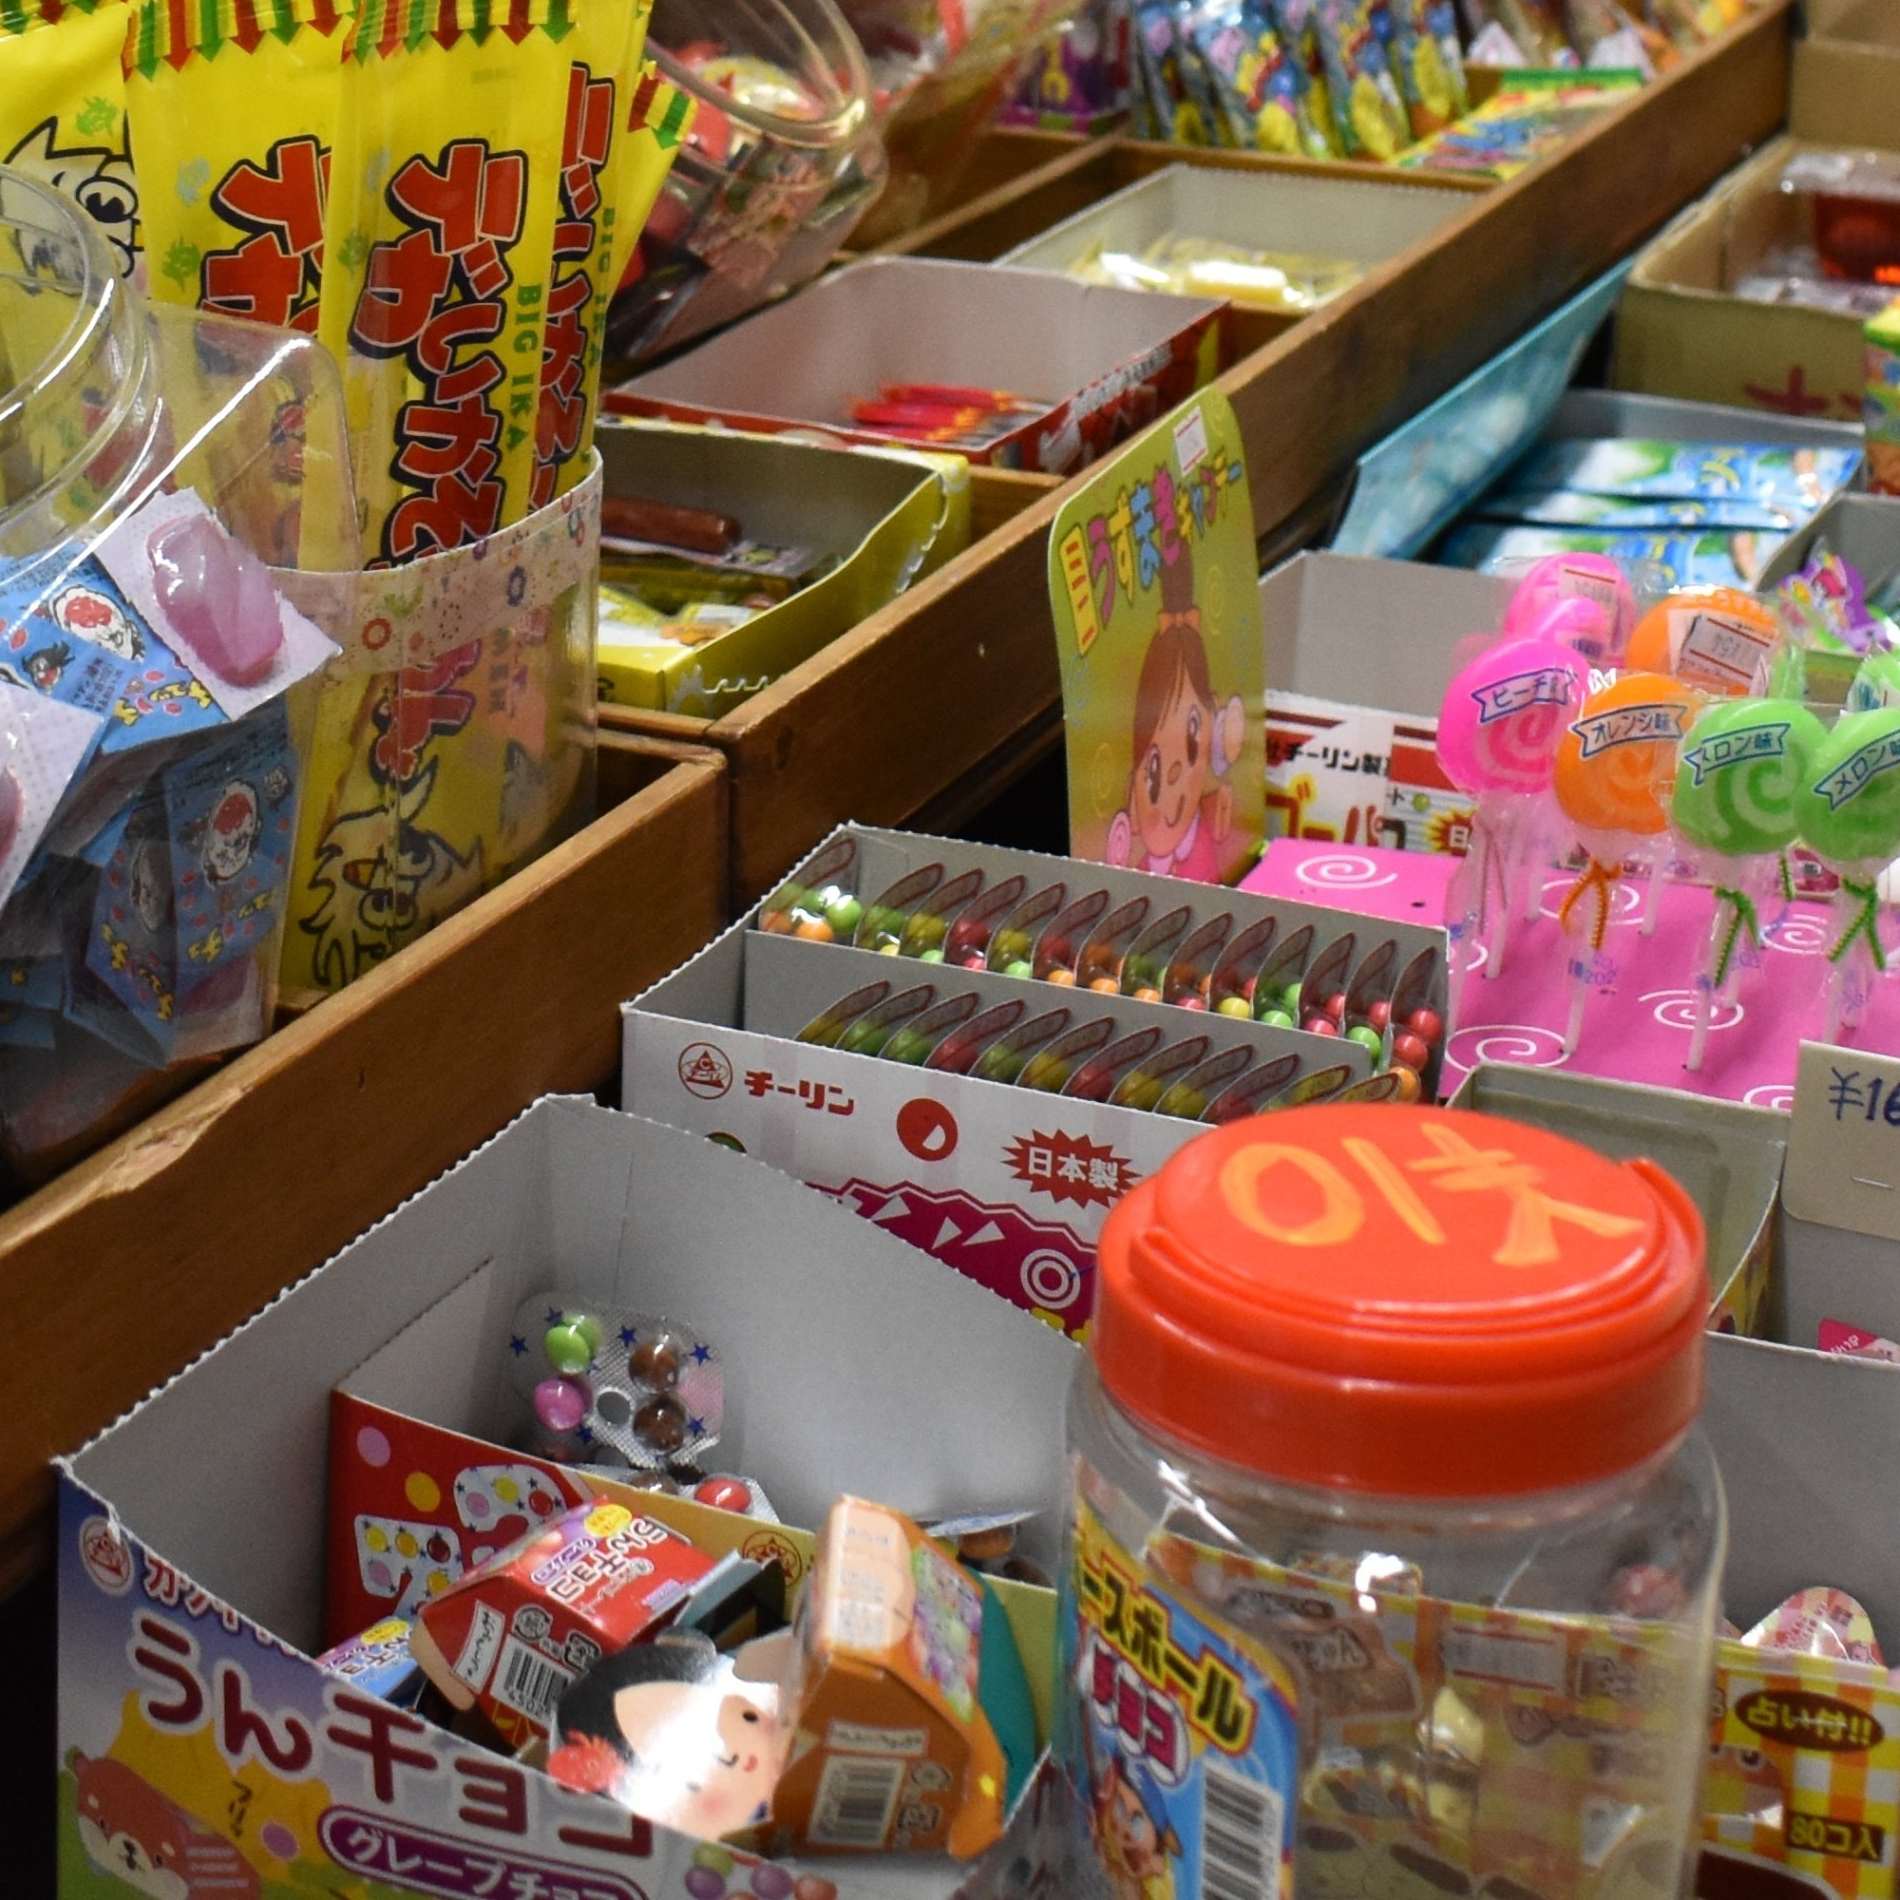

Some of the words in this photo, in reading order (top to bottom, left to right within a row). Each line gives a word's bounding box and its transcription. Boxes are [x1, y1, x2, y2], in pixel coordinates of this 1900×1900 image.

[514, 283, 542, 351] BIG
[505, 371, 538, 454] IKA
[743, 1068, 856, 1117] チーリン
[1027, 1145, 1120, 1191] 日本製
